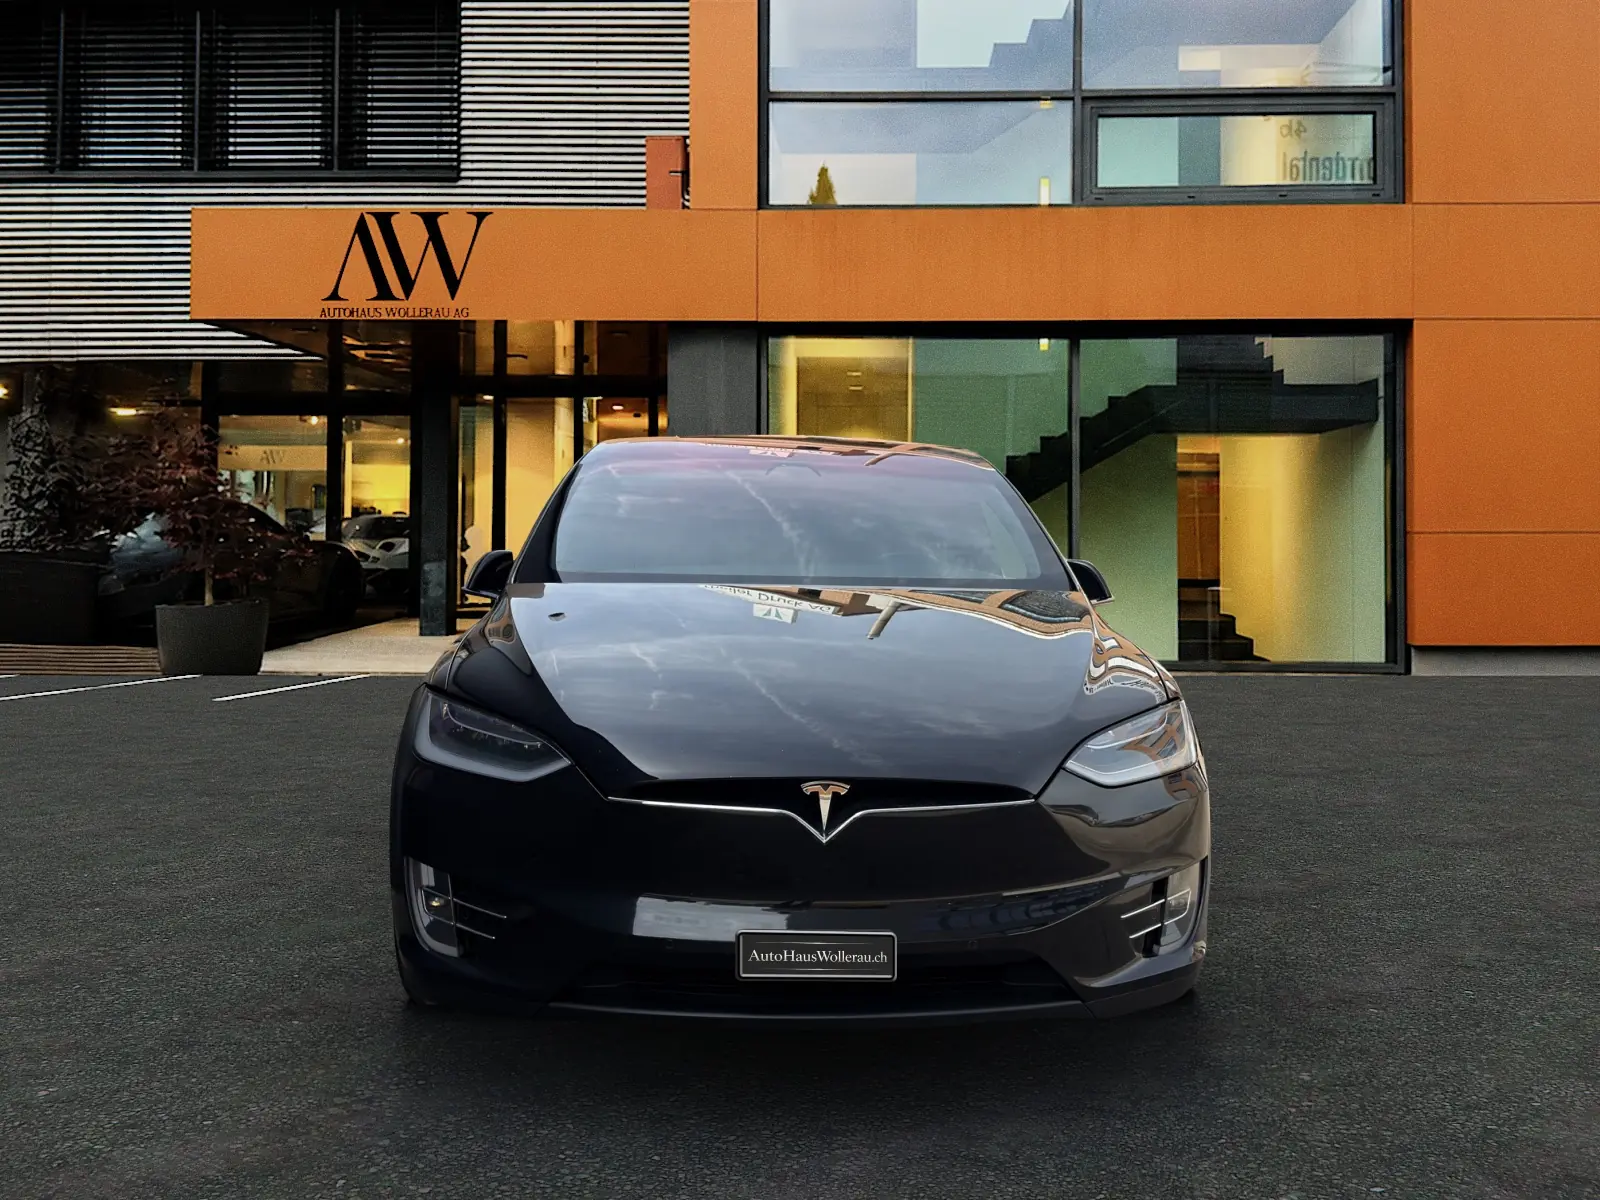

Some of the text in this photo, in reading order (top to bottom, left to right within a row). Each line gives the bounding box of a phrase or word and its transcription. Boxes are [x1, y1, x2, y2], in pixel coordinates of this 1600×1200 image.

[320, 211, 494, 301] AW
[319, 307, 470, 318] AUTOHAUS WOLLERAU AG
[747, 949, 888, 963] AutoHausWollerau.ch
